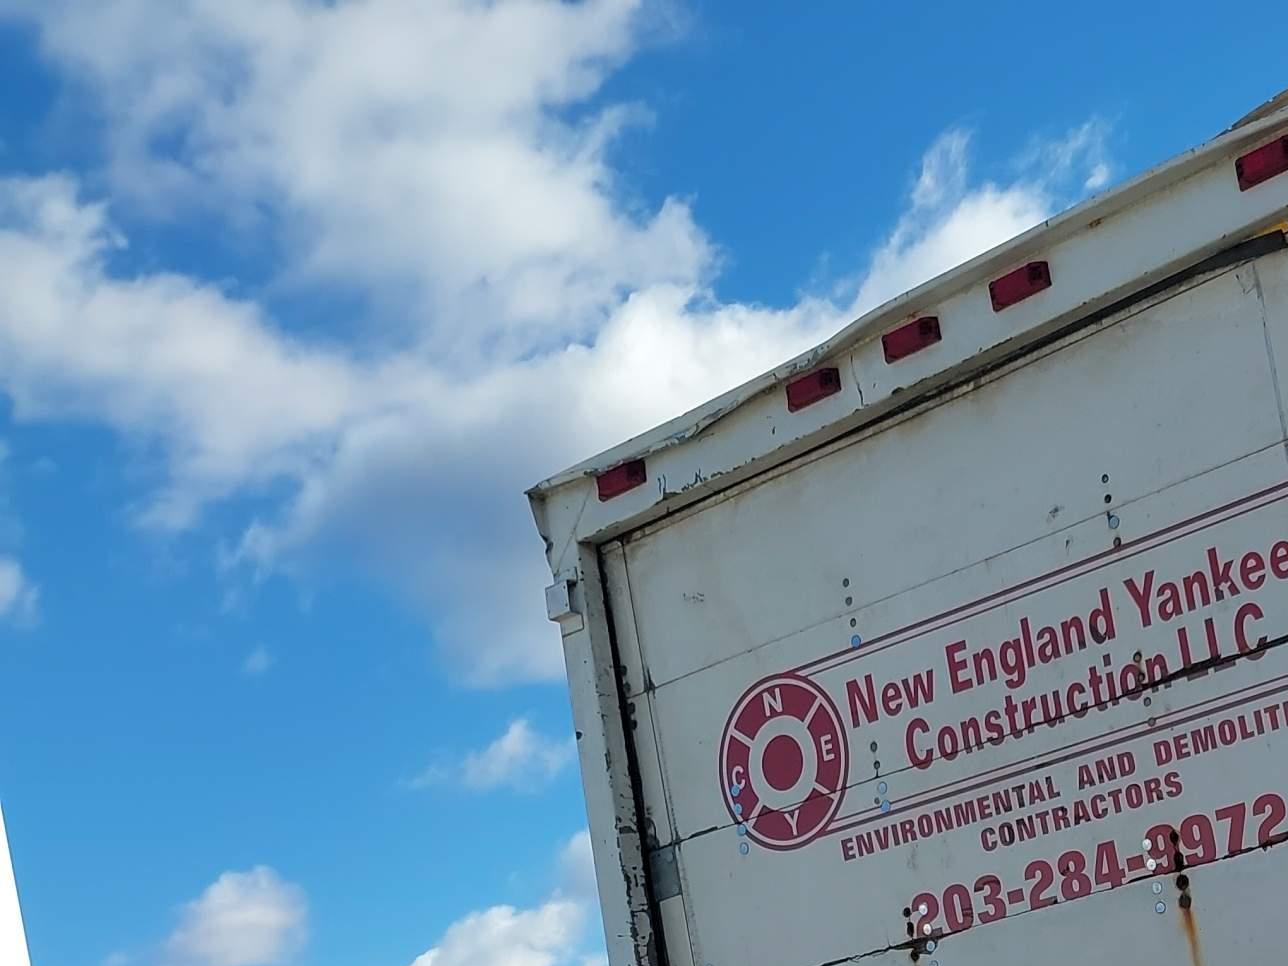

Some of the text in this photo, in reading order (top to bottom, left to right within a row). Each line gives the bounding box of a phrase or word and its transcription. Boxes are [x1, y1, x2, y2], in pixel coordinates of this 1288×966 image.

[846, 669, 934, 729] New
[945, 588, 1117, 694] England
[905, 602, 1269, 770] Construction LLC
[731, 687, 835, 836] N E Y C
[840, 776, 1061, 862] ENVIRONMENTAL
[1078, 751, 1136, 790] AND
[980, 771, 1184, 852] CONTRACTORS
